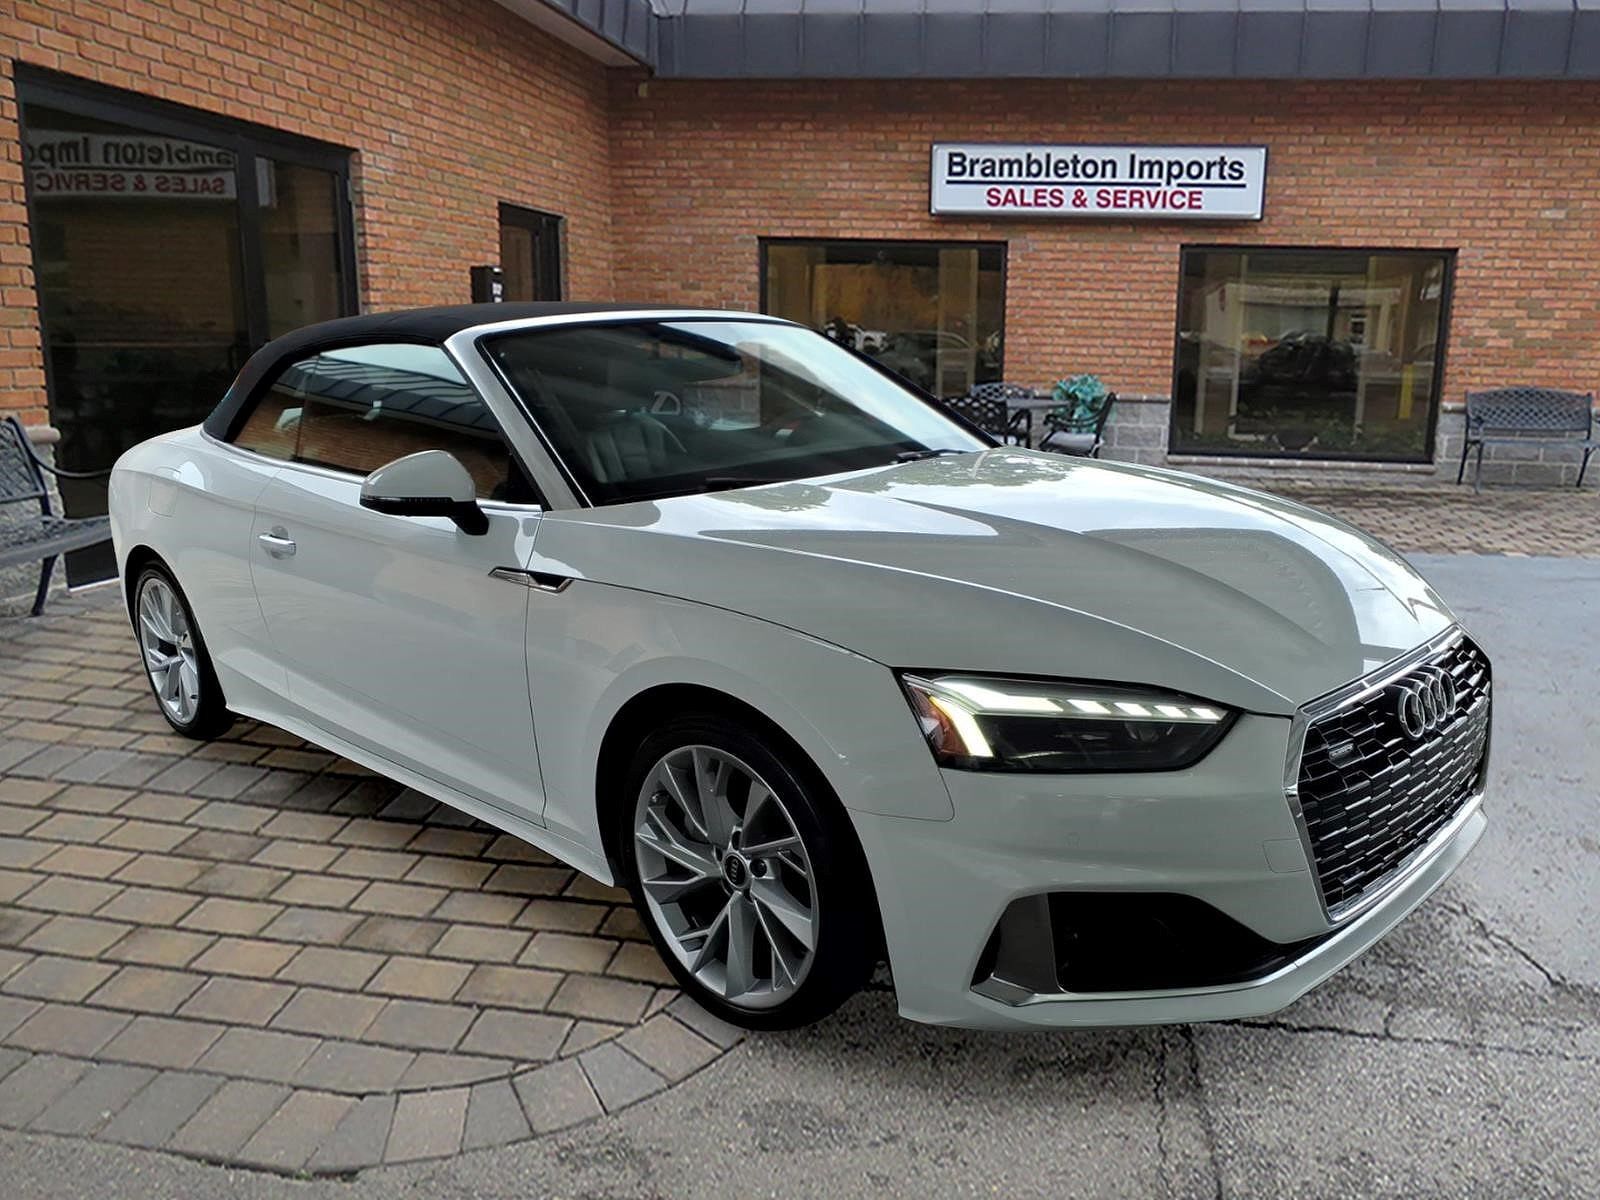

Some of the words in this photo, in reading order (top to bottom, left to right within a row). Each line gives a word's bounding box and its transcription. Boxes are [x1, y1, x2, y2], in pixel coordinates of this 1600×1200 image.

[948, 152, 1117, 179] Brambleton
[1129, 154, 1245, 186] Imports
[986, 188, 1064, 208] SALES
[1072, 189, 1088, 208] &
[1096, 189, 1203, 210] SERVICE
